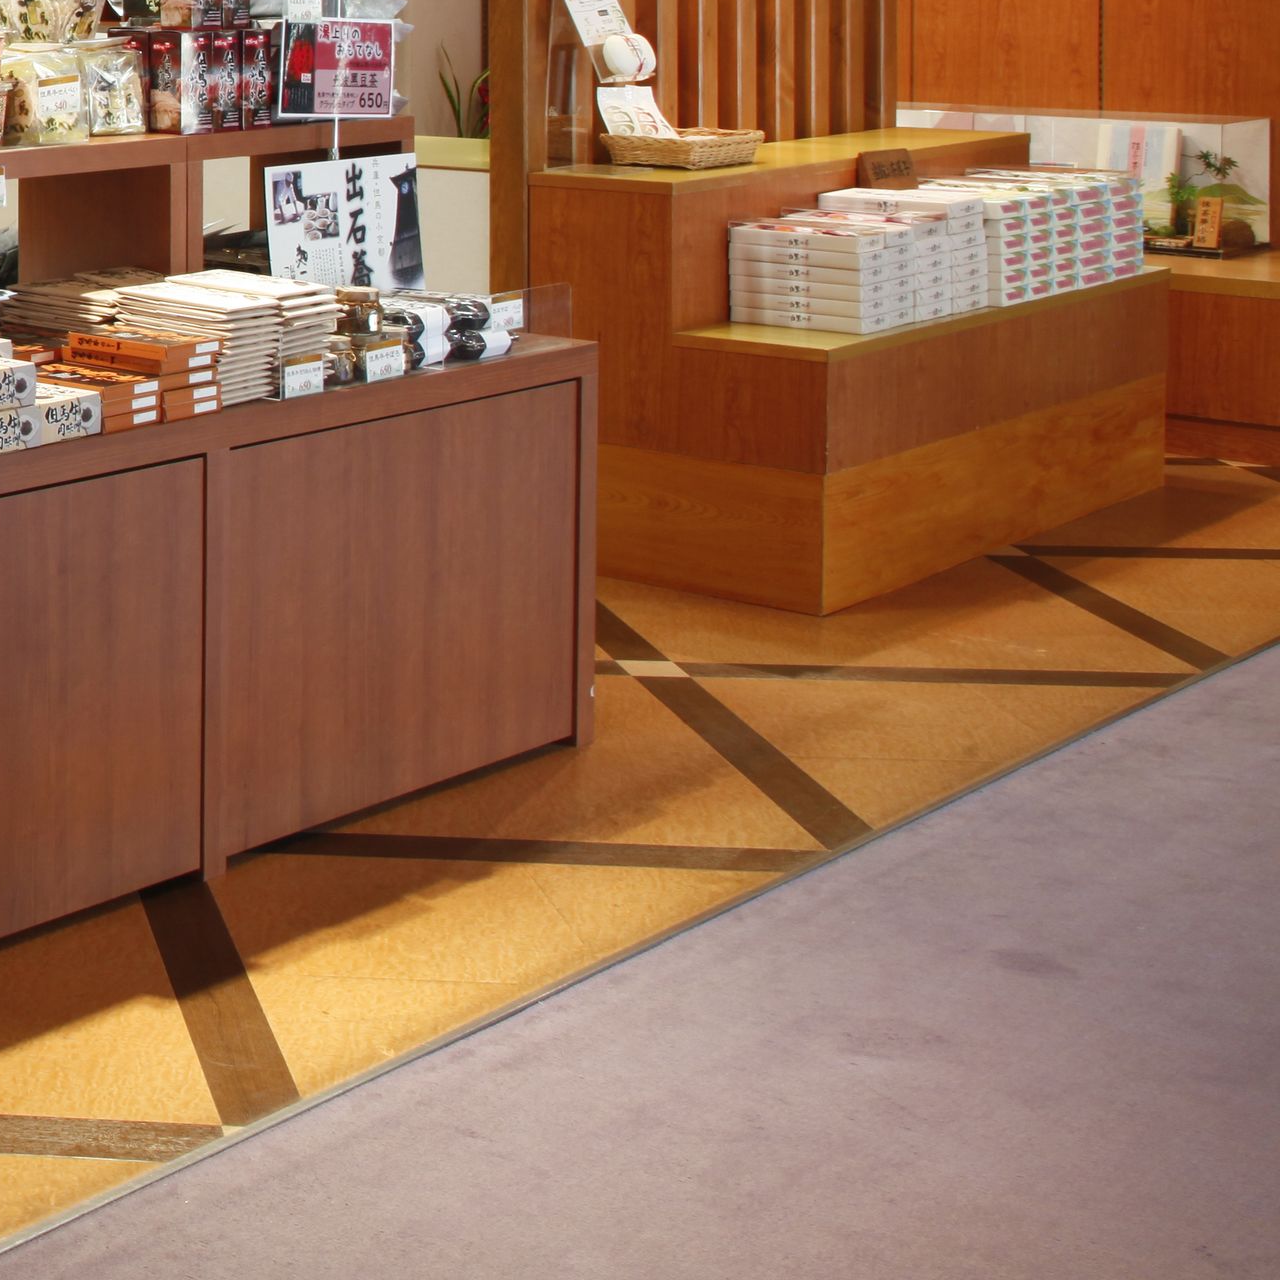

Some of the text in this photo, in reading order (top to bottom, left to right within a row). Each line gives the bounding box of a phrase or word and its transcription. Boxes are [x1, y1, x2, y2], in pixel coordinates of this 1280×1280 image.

[336, 43, 382, 57] おもてなし
[44, 401, 82, 424] 但馬牛
